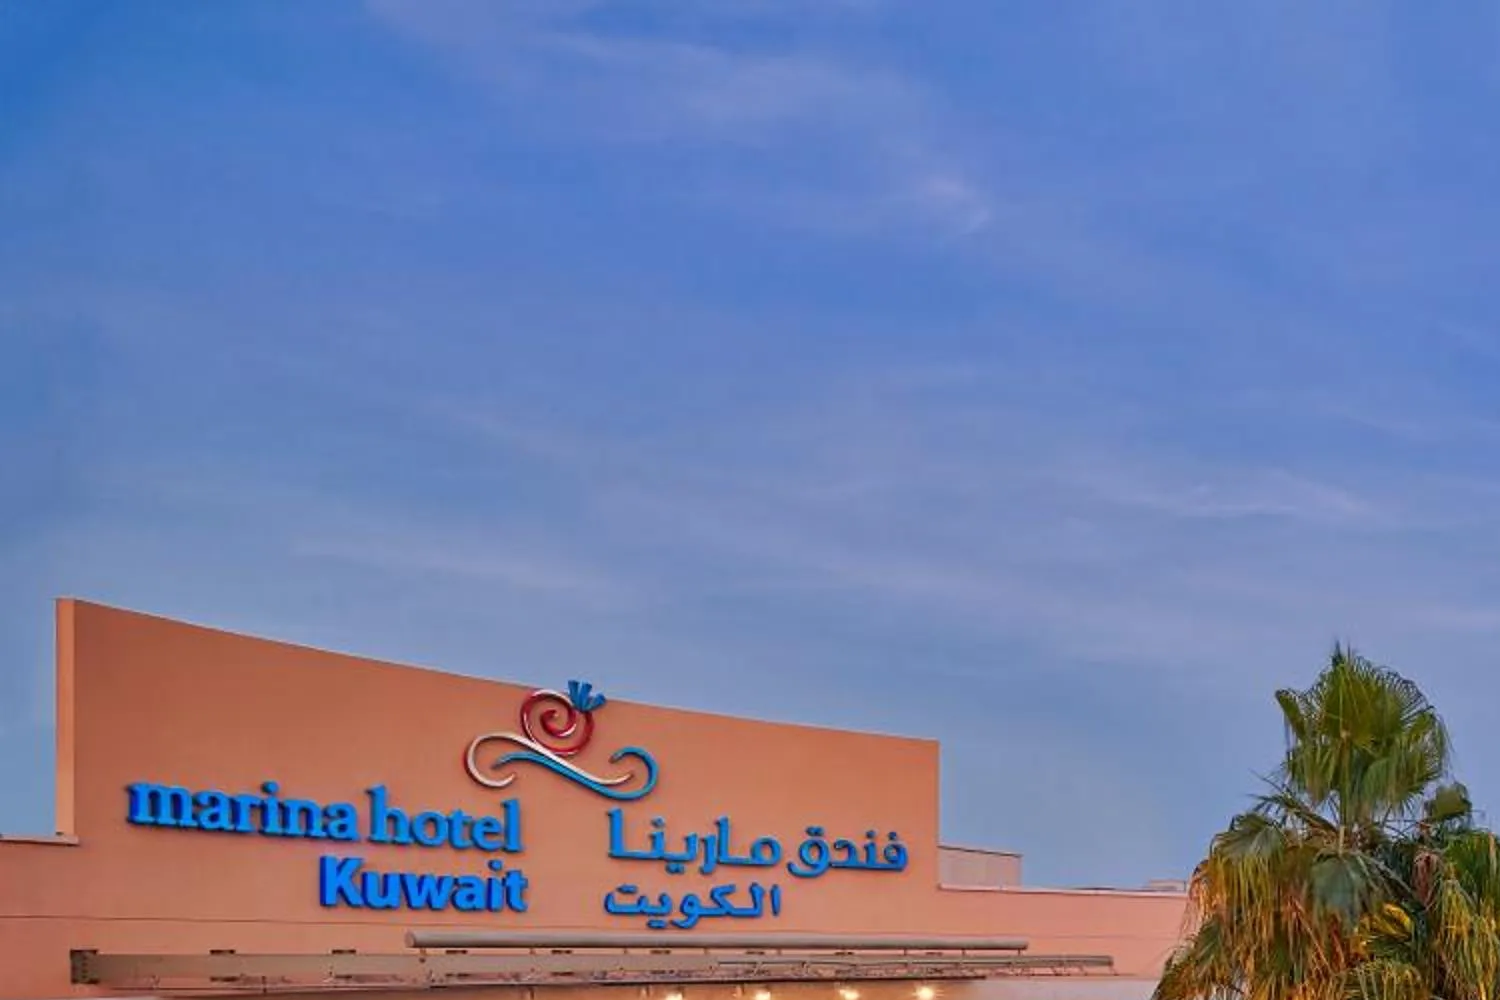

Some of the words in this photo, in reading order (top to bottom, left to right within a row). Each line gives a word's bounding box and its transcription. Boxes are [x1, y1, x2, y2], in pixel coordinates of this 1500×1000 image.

[127, 781, 359, 842] marina
[367, 784, 524, 852] hotel
[608, 807, 783, 875] مارينا
[787, 827, 909, 878] فندق
[318, 856, 530, 912] Kuwait
[604, 882, 783, 929] الكويت
